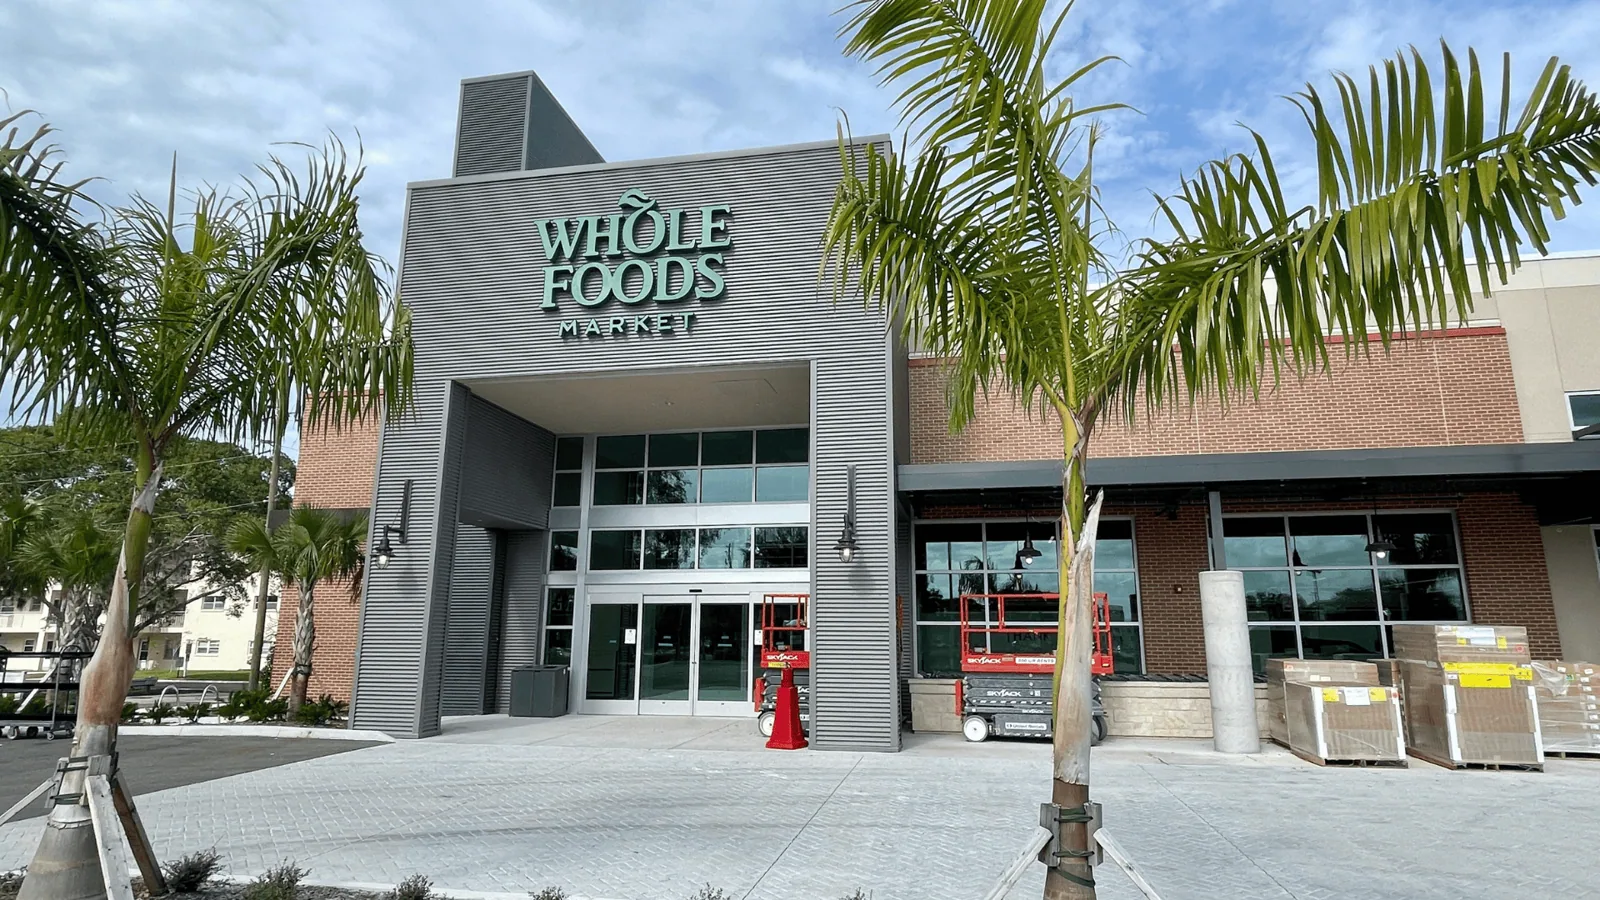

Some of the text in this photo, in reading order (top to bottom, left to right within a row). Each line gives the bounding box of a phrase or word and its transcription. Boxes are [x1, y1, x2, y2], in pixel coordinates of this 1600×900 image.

[534, 188, 731, 260] WHOLE
[539, 253, 725, 309] FOODS
[558, 312, 694, 337] MARKET
[766, 653, 798, 661] SKYJACK
[967, 656, 1002, 664] SKYJACK
[986, 689, 1022, 697] SKYJACK
